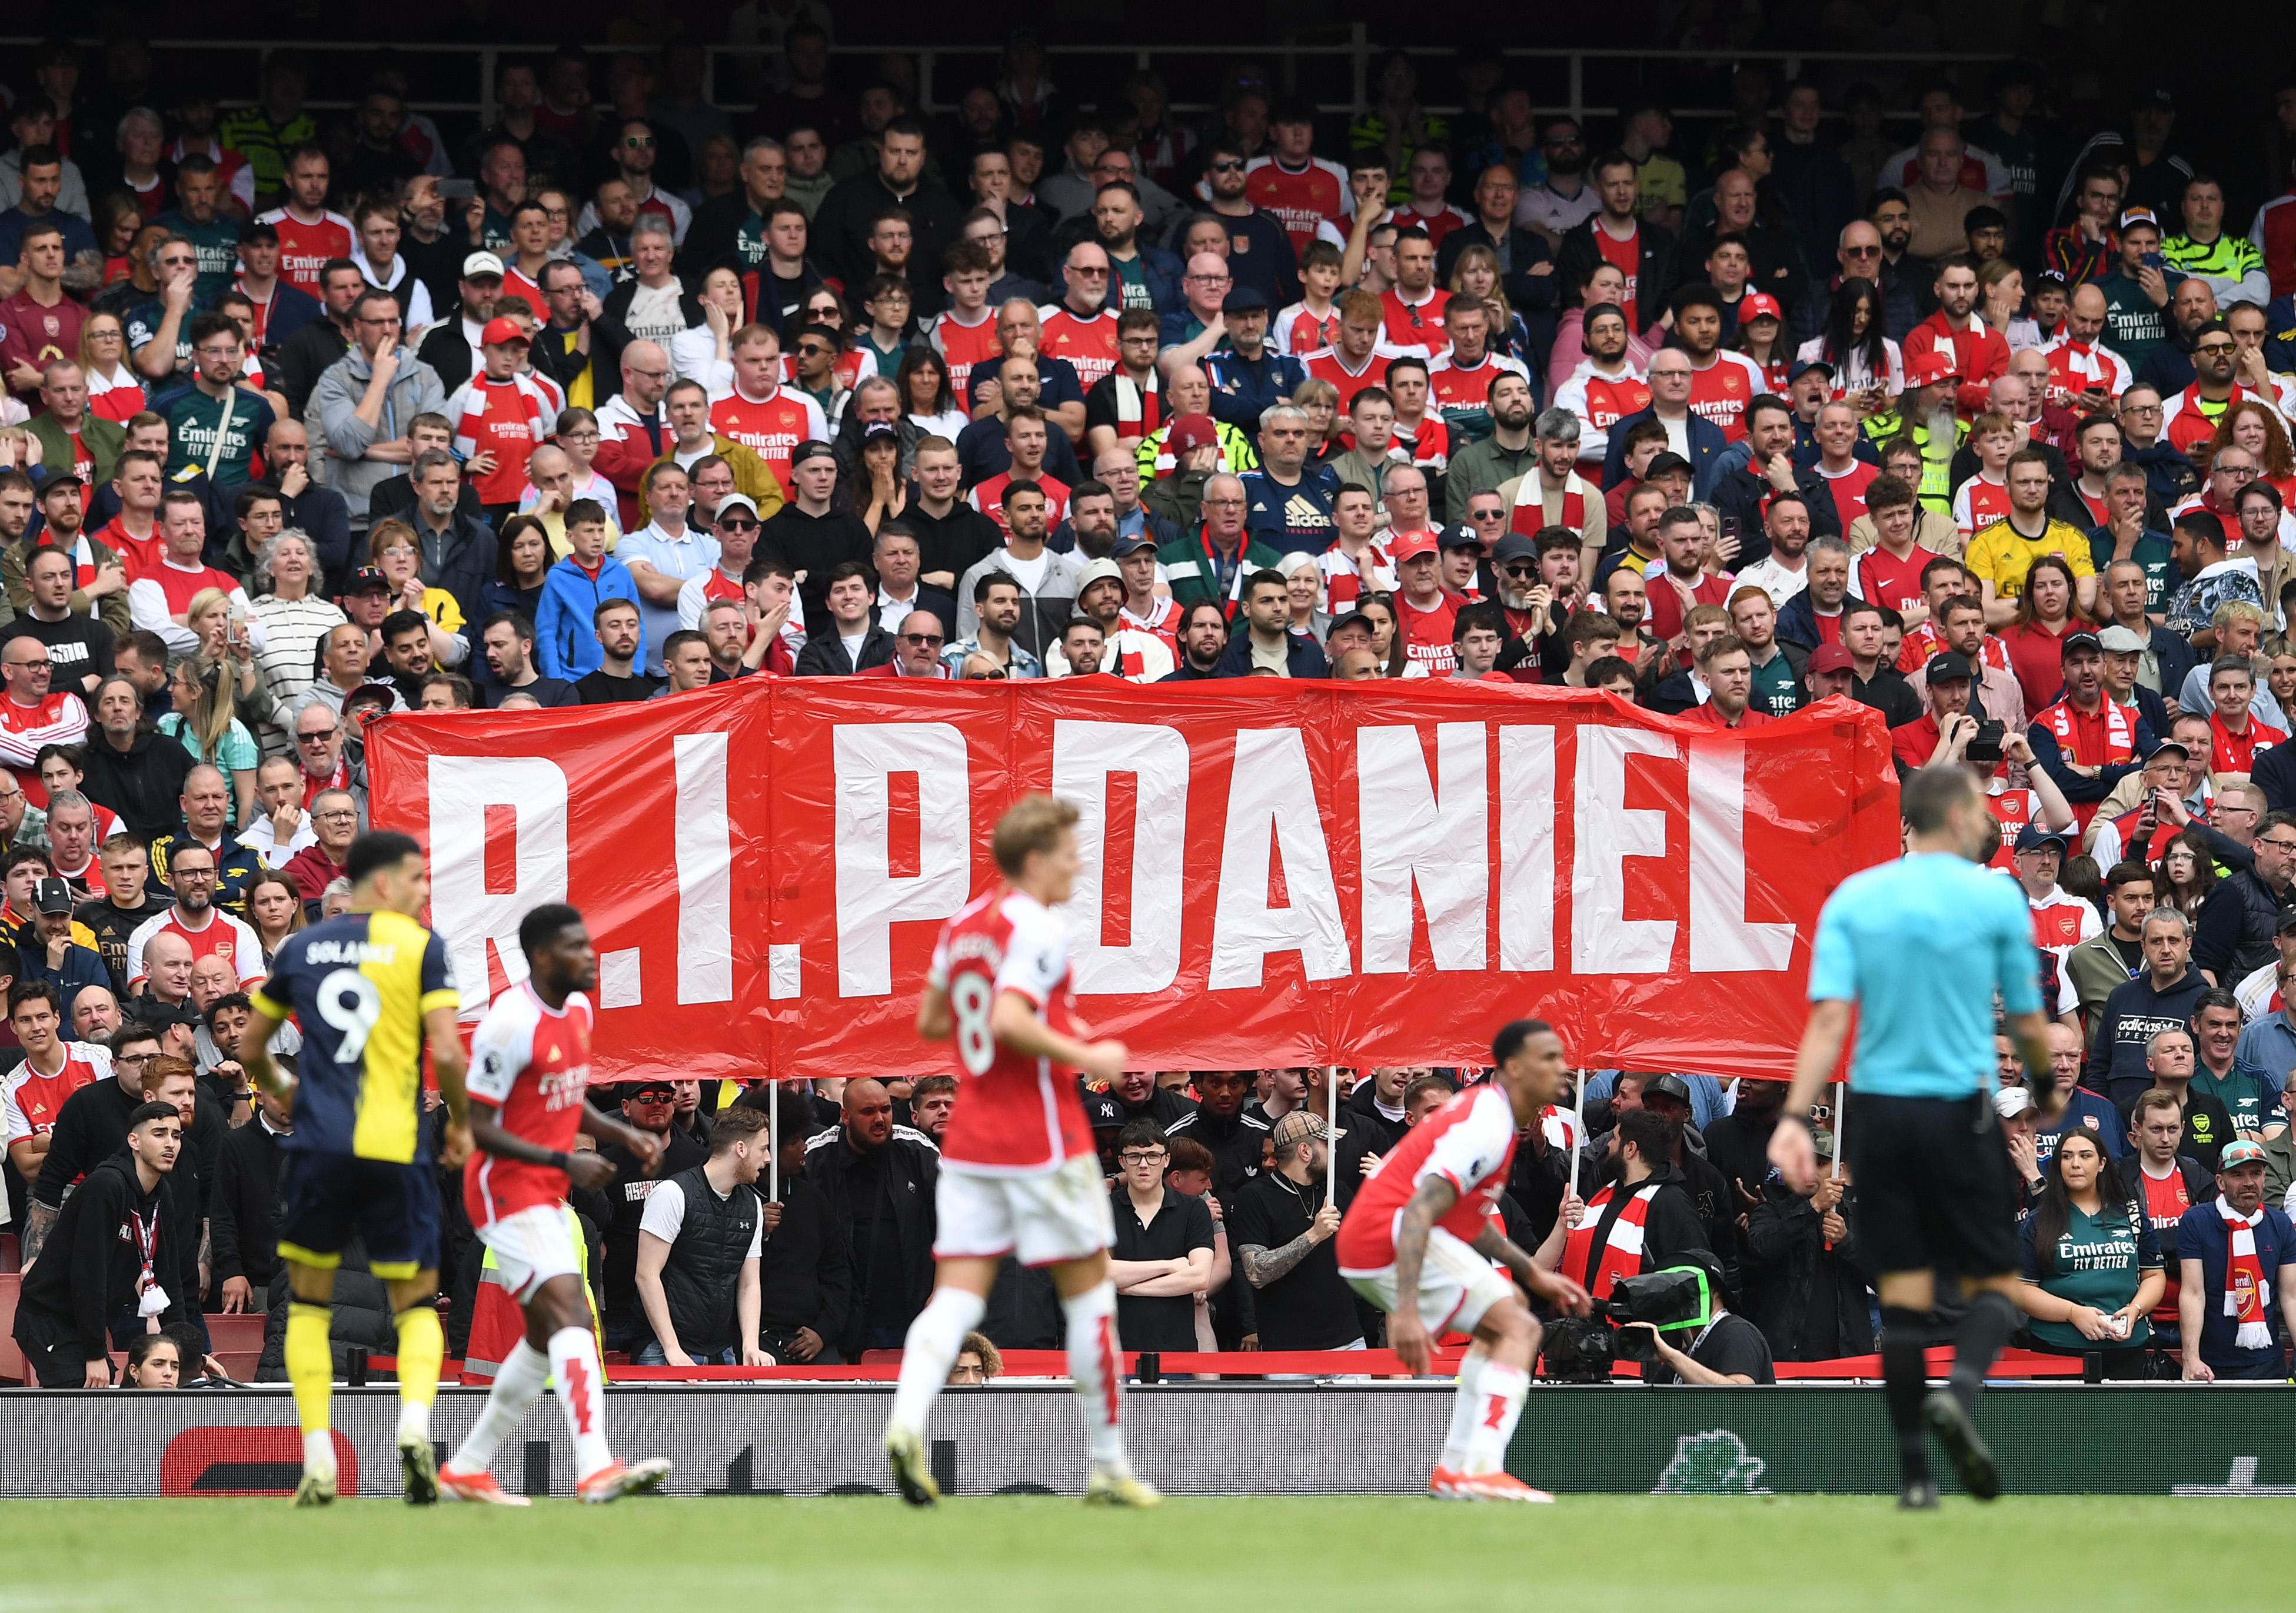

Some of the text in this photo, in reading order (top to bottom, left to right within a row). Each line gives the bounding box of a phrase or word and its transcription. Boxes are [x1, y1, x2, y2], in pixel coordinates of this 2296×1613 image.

[1270, 207, 1323, 222] mirates
[282, 254, 333, 271] Emira
[2118, 327, 2165, 341] FLY BETTER
[178, 427, 247, 447] Emirtes
[728, 430, 799, 447] Emirates
[187, 443, 204, 456] FLY
[757, 447, 789, 460] BETTER
[1285, 512, 1332, 527] adidas
[1406, 643, 1455, 659] Emira
[1051, 719, 1796, 995] DANIEL
[317, 968, 381, 1064] 9
[951, 970, 996, 1076] 8
[2059, 1241, 2136, 1259] Emirates
[2074, 1255, 2129, 1271] FLY BETTER
